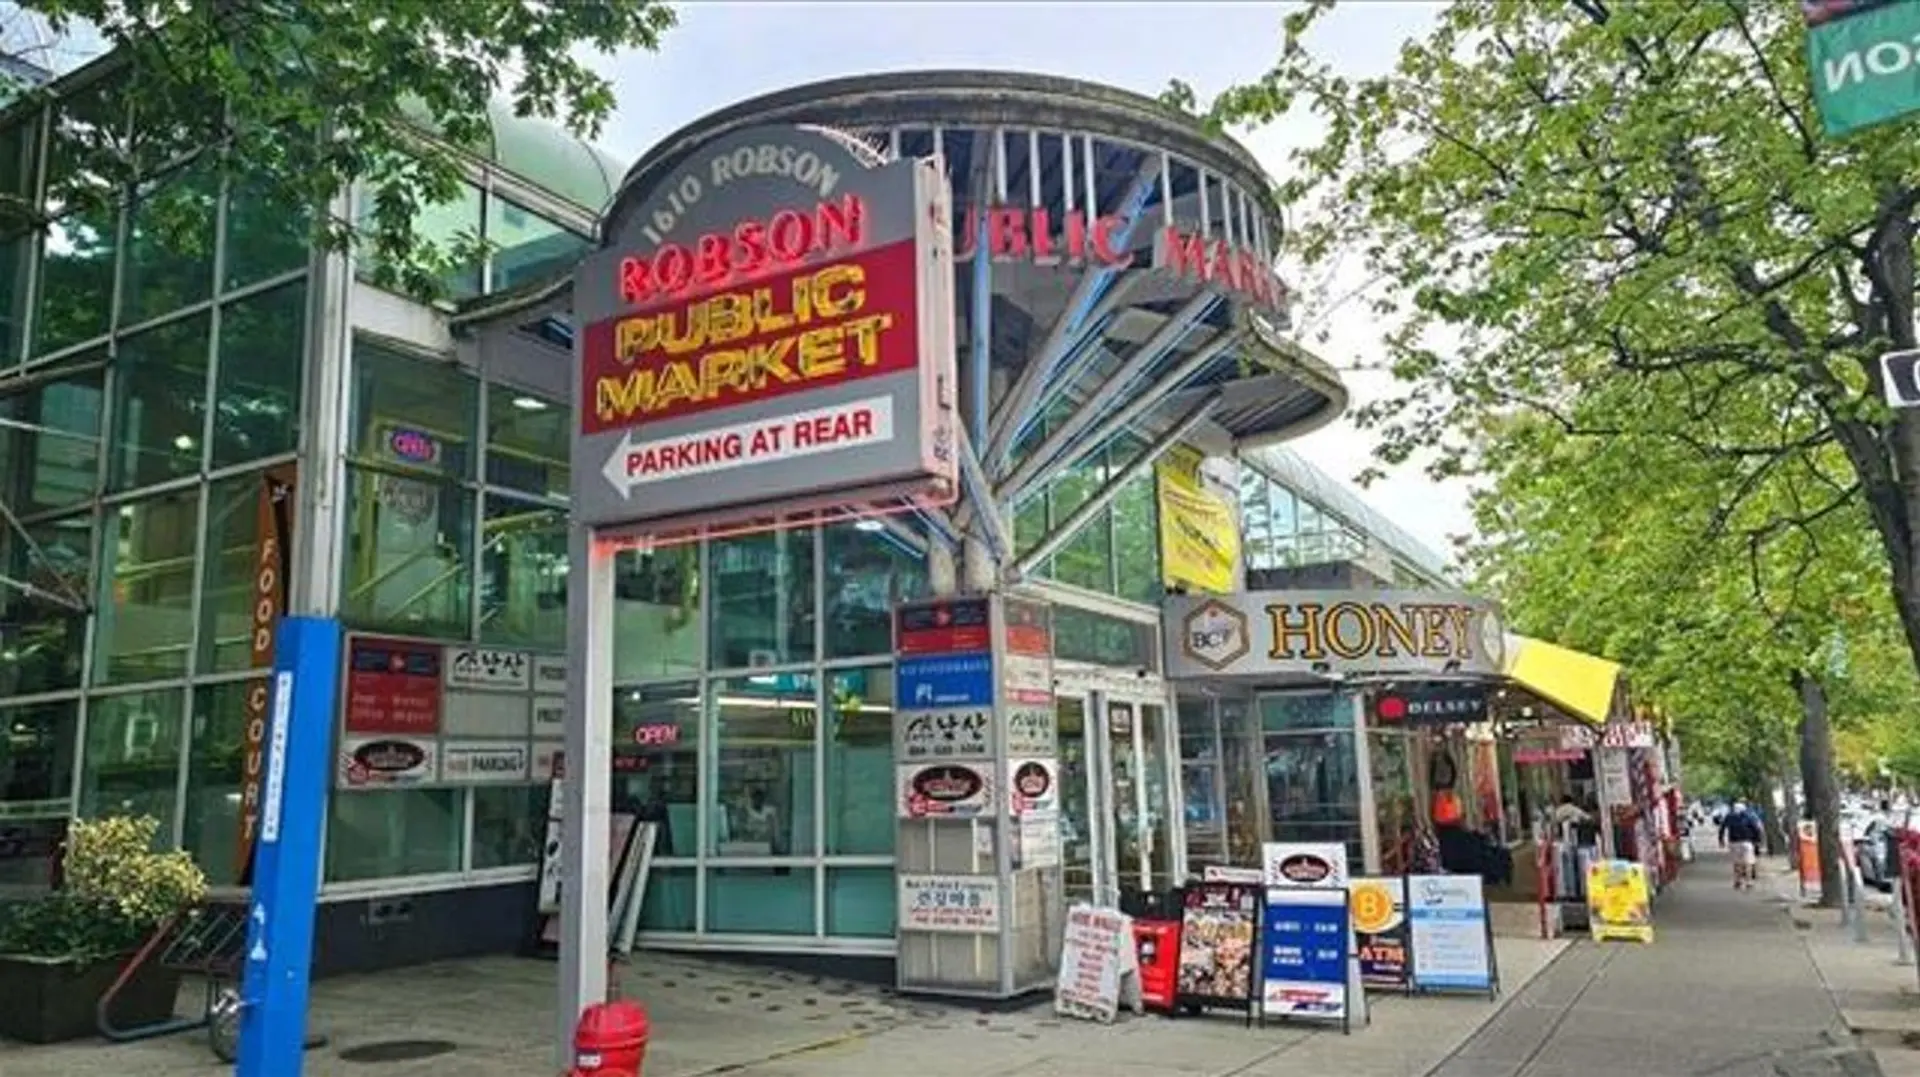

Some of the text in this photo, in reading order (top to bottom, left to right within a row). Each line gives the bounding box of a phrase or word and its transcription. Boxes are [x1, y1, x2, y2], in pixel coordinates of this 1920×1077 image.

[641, 144, 841, 246] 1610 ROBSON
[619, 193, 866, 303] ROBSON
[615, 264, 866, 363] PUBLIC
[596, 313, 893, 421] MARKET
[626, 409, 873, 477] PARKING AT REAR
[1265, 602, 1472, 660] HONEY
[243, 540, 276, 838] FOOD COURT
[635, 725, 677, 745] OPEN
